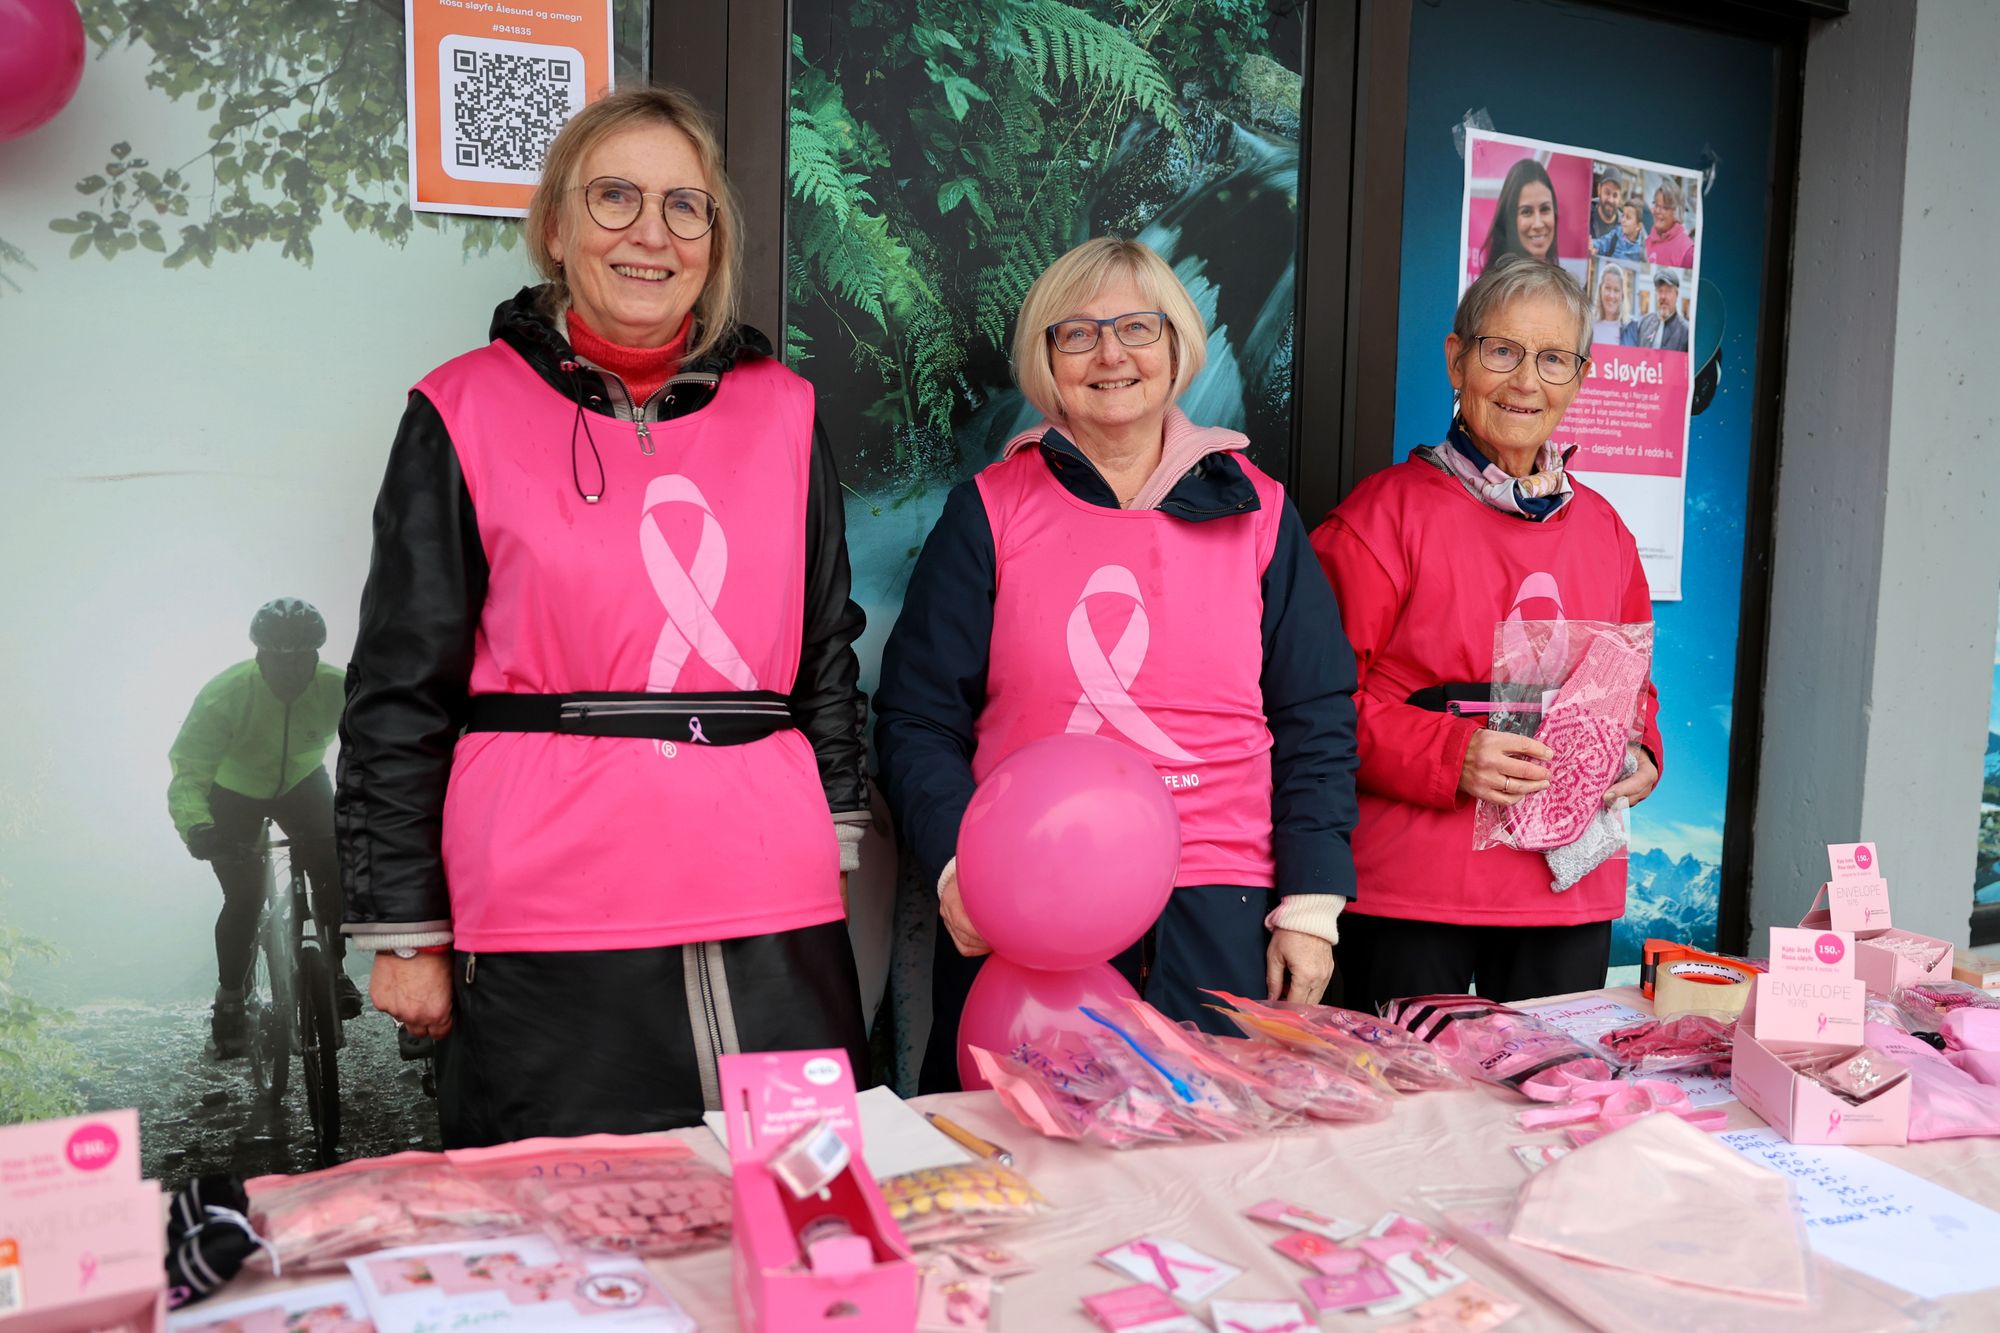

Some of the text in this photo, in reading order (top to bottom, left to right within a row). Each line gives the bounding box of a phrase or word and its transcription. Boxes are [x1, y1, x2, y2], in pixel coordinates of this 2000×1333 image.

[465, 1, 493, 12] sløyfe
[496, 4, 534, 17] Ålesund
[535, 11, 548, 20] og
[550, 13, 583, 22] omegn
[492, 23, 532, 36] #941835
[1603, 358, 1663, 387] sløyfe!
[1591, 443, 1624, 457] designet
[1625, 445, 1636, 456] for
[1638, 444, 1643, 456] å
[1644, 447, 1664, 458] redde
[1836, 884, 1881, 899] ENVELOPE
[1819, 944, 1841, 956] 150,-
[1771, 981, 1852, 1000] ENVELOPE
